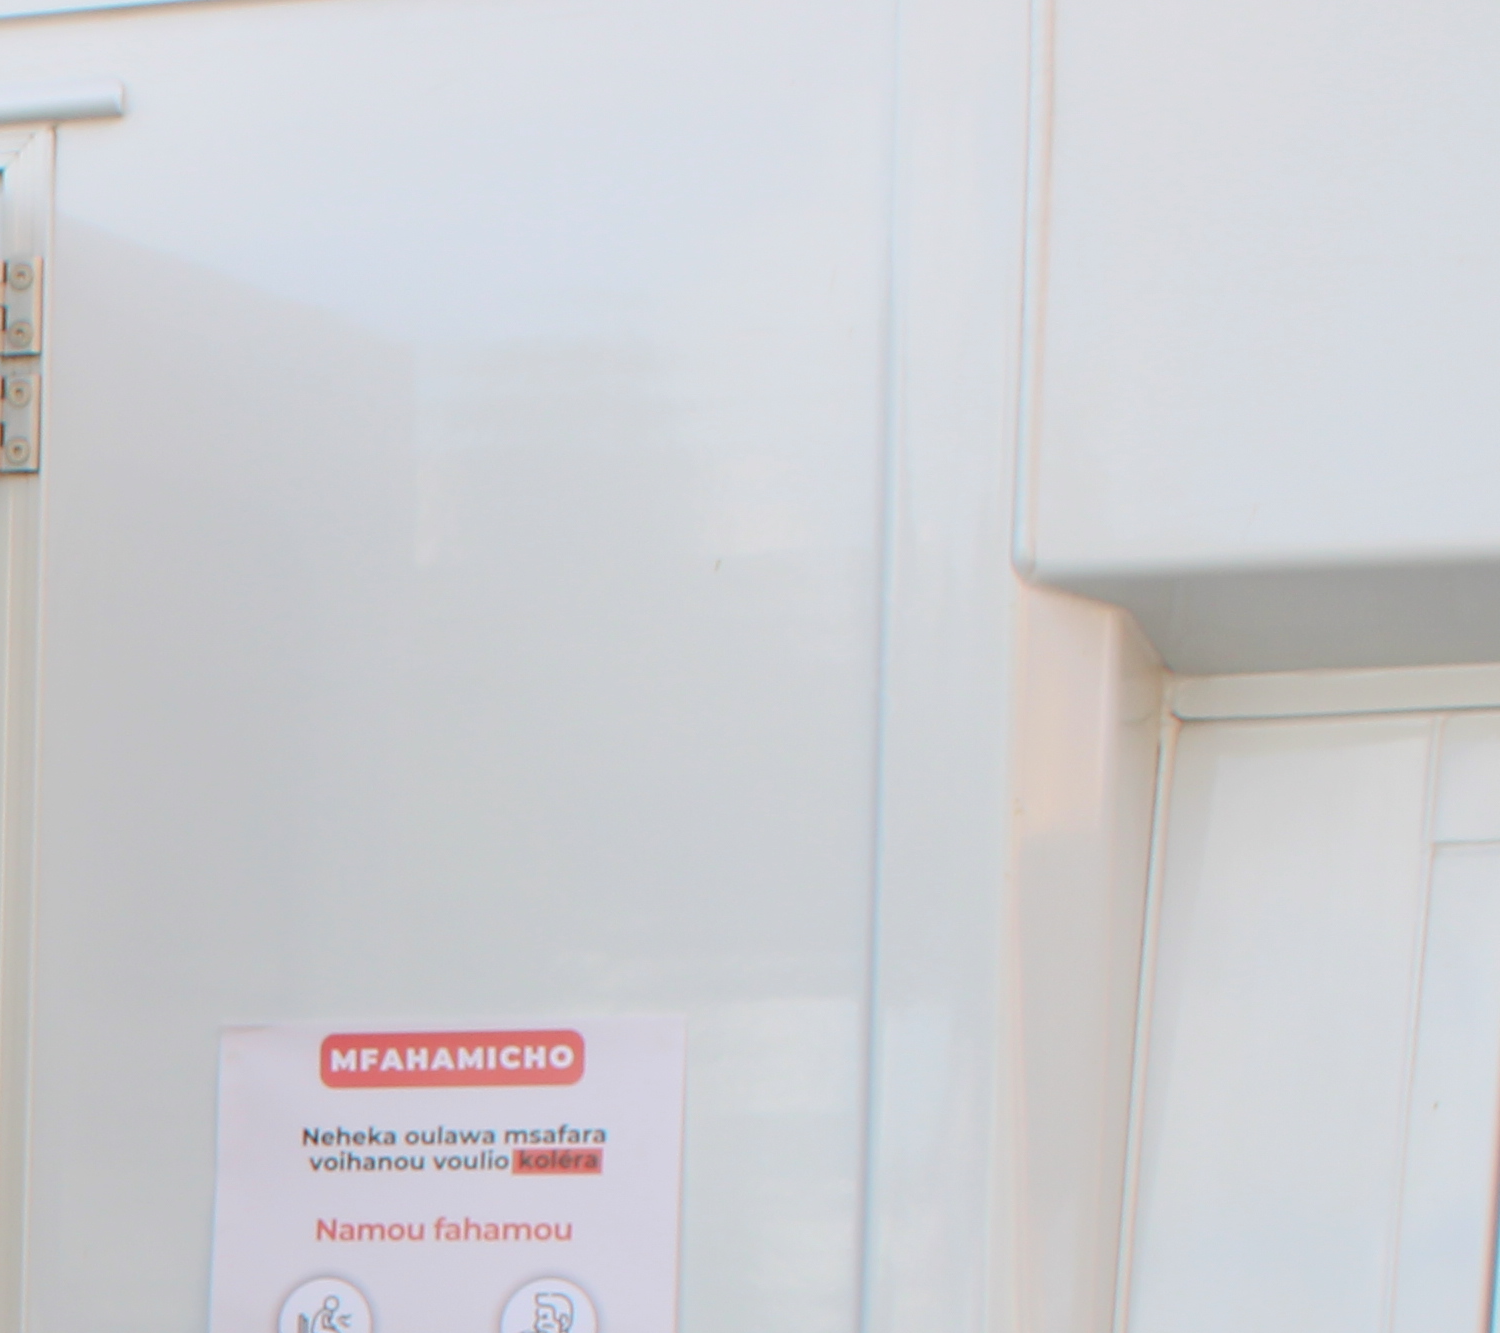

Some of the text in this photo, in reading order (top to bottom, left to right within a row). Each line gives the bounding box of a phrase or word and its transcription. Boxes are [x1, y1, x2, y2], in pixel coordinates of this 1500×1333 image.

[330, 1044, 575, 1073] MFAHAMICHO
[302, 1124, 608, 1146] Neheka oulawa msafara
[309, 1147, 598, 1171] voihanou voulio koléra
[316, 1216, 573, 1242] Namou fahamou
